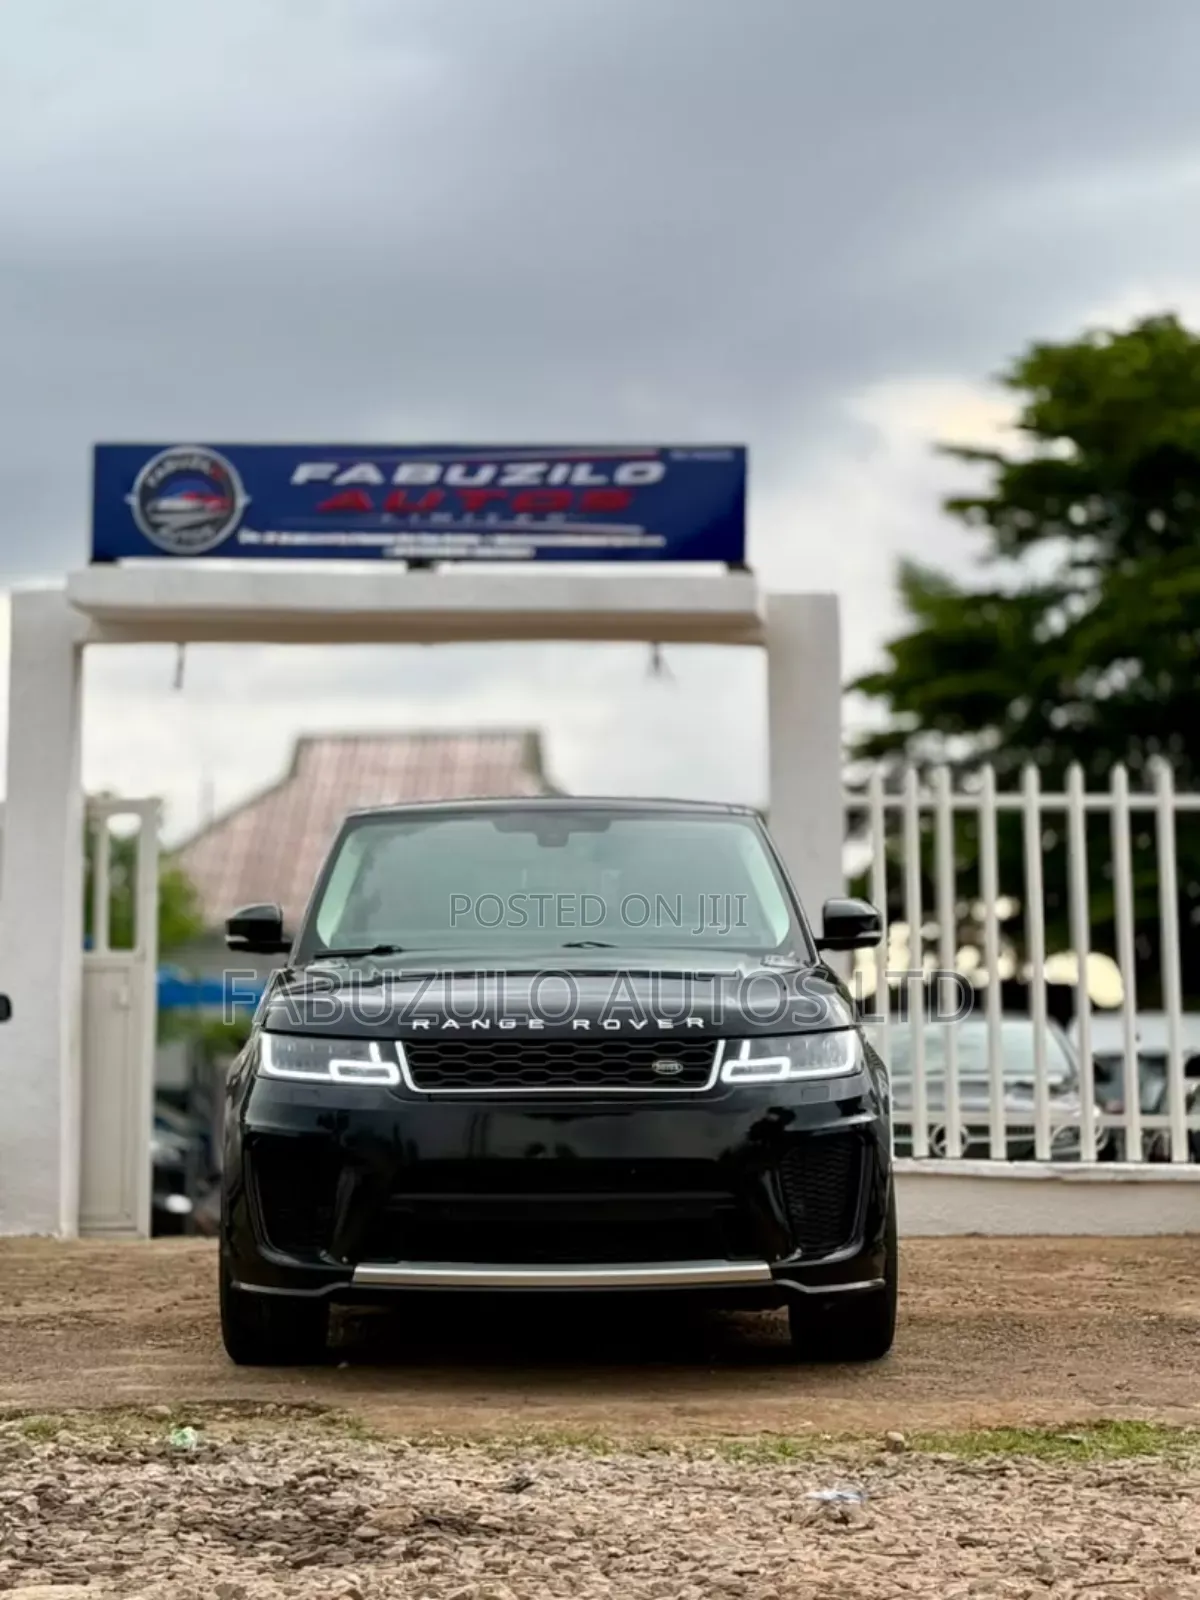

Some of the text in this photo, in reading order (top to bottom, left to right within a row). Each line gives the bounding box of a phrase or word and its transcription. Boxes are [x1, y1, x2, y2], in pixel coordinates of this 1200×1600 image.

[290, 461, 667, 486] FABUZILO
[315, 487, 635, 513] AUTOS
[411, 1017, 706, 1031] RANGE ROVER
